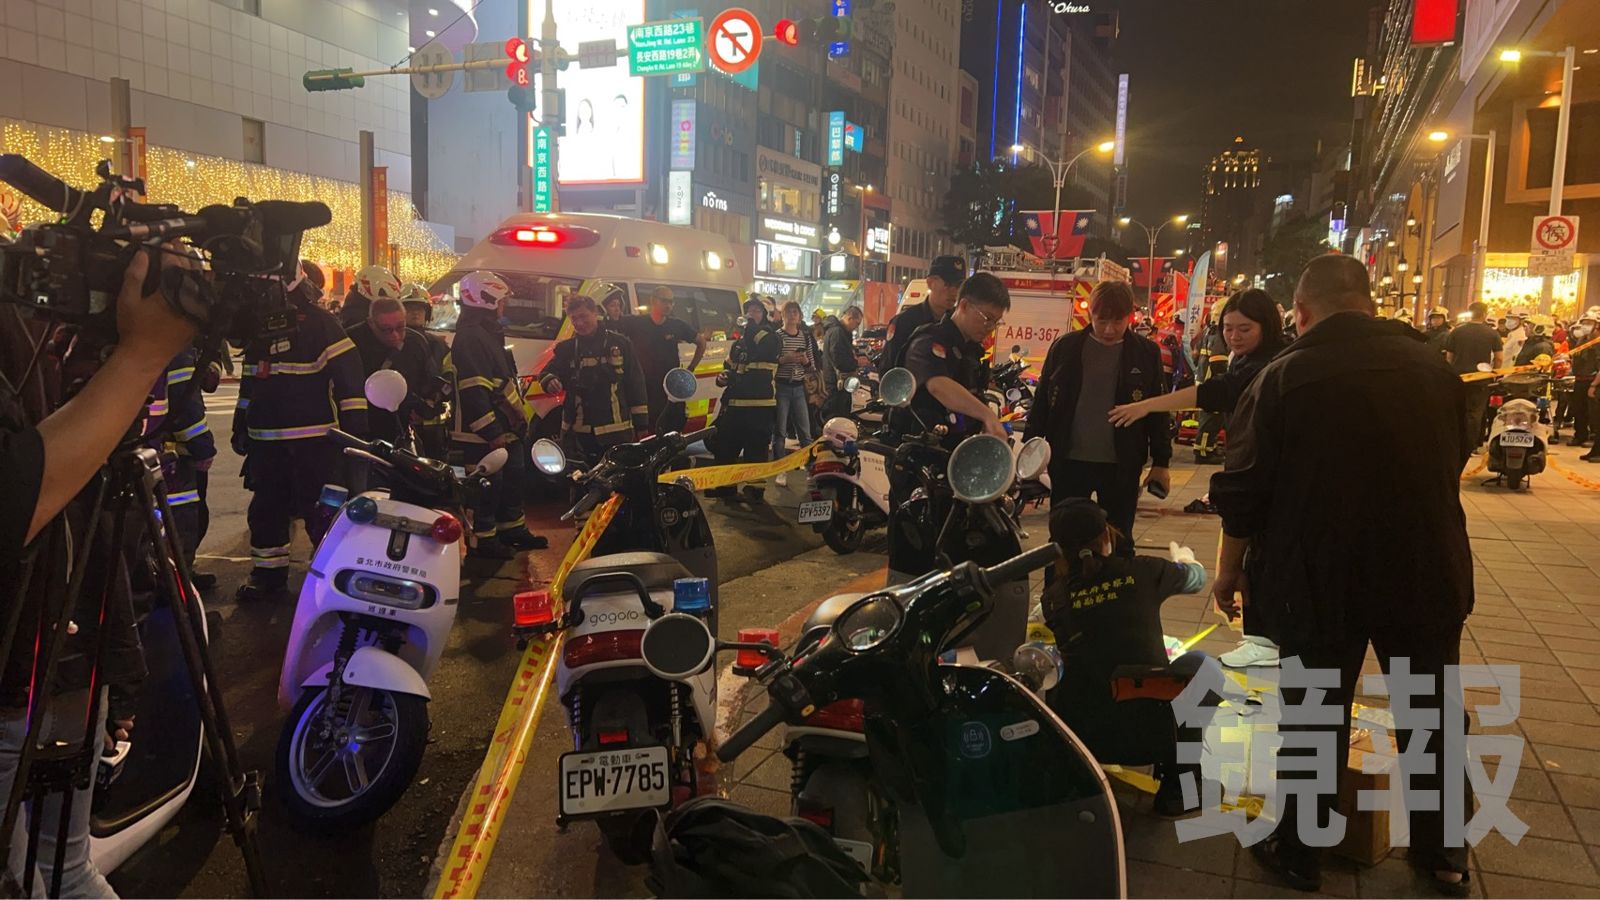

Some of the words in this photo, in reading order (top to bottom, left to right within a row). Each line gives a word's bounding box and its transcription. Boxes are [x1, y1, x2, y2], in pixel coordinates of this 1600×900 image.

[1054, 2, 1090, 14] Okura
[635, 22, 695, 39] 南京西路23巷
[537, 138, 547, 193] 南京西路
[1005, 326, 1060, 342] AAB-367
[356, 557, 427, 578] 臺北市政府警察局
[589, 609, 639, 627] gogoro
[598, 754, 632, 767] 電動車
